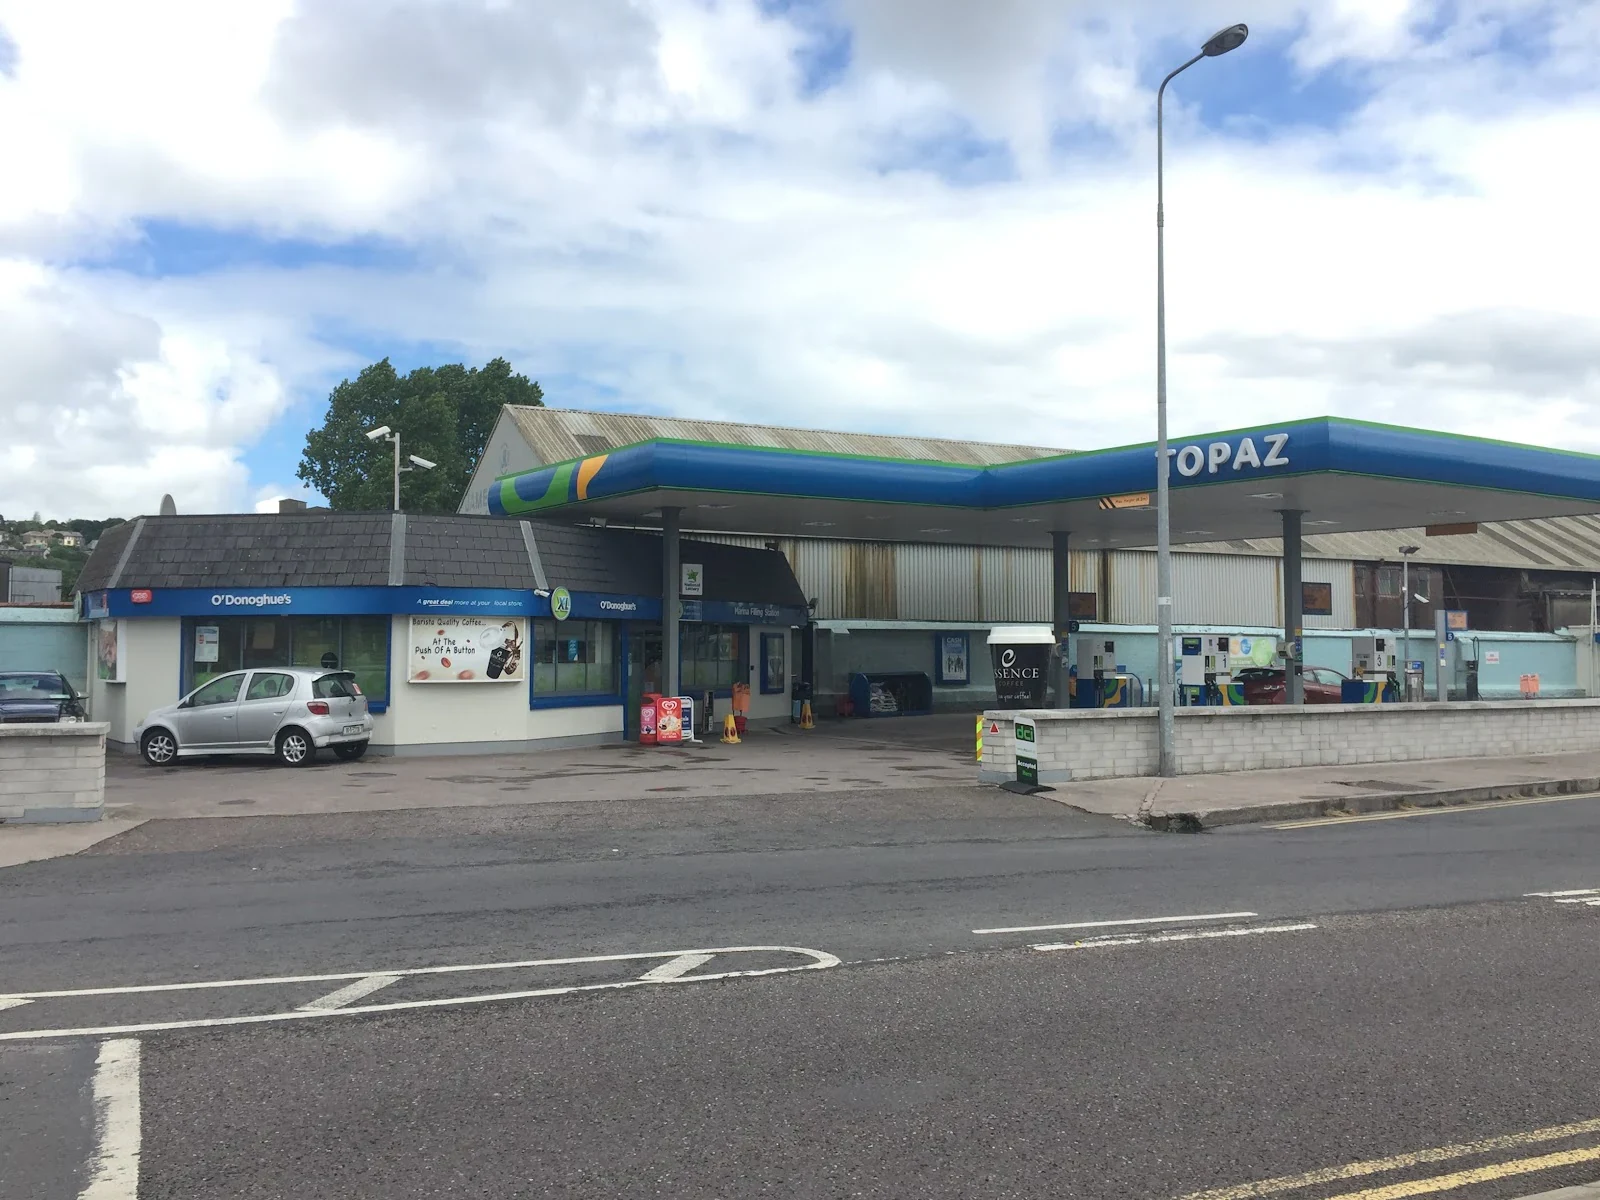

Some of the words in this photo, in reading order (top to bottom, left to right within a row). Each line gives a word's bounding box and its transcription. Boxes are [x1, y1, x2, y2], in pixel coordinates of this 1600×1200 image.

[211, 594, 291, 607] O'Donoghue's
[600, 601, 636, 611] O'Donoghue's
[734, 607, 749, 616] Marina
[750, 608, 763, 617] Filling
[765, 609, 780, 617] Station
[412, 618, 434, 626] Barista
[437, 618, 460, 627] Quality
[994, 668, 1039, 678] SSENCE
[1016, 725, 1034, 741] dci
[1017, 760, 1036, 770] Accepted
